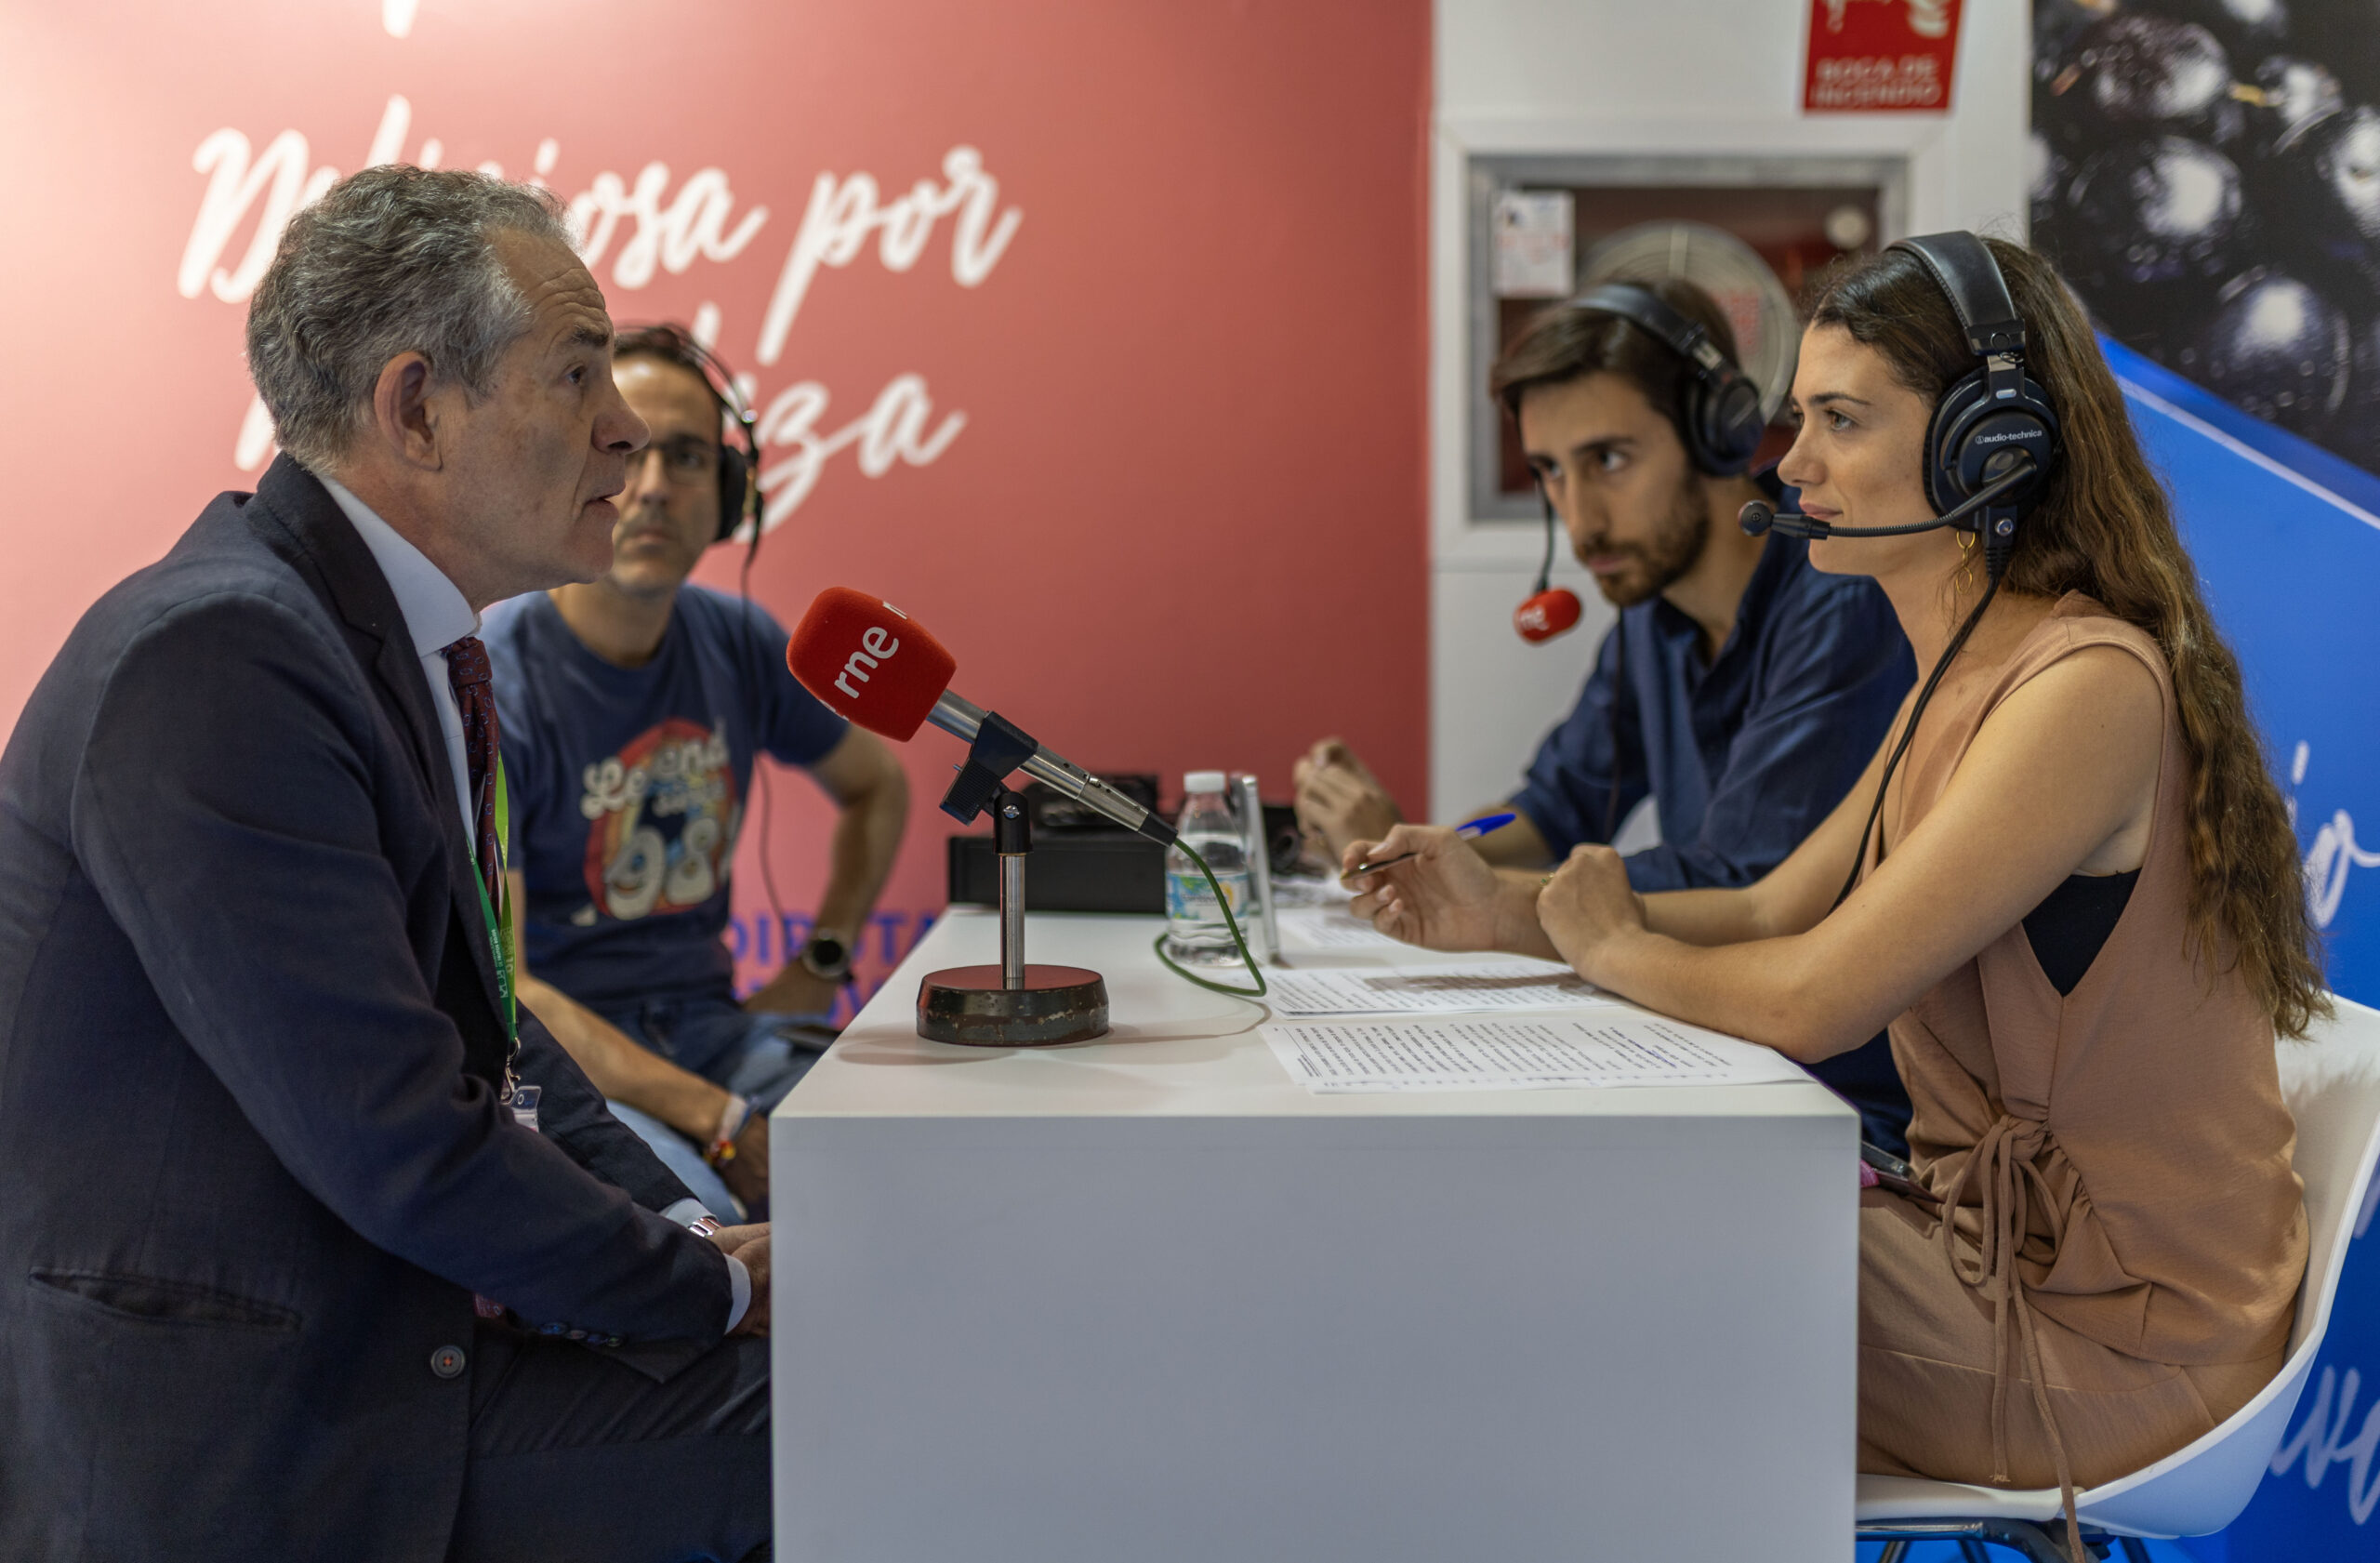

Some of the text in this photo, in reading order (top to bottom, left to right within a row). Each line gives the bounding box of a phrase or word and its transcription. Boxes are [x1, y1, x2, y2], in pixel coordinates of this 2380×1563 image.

[1898, 53, 1940, 81] DE
[756, 144, 1023, 365] por
[1983, 429, 2043, 444] audio-technica
[834, 626, 899, 698] rne
